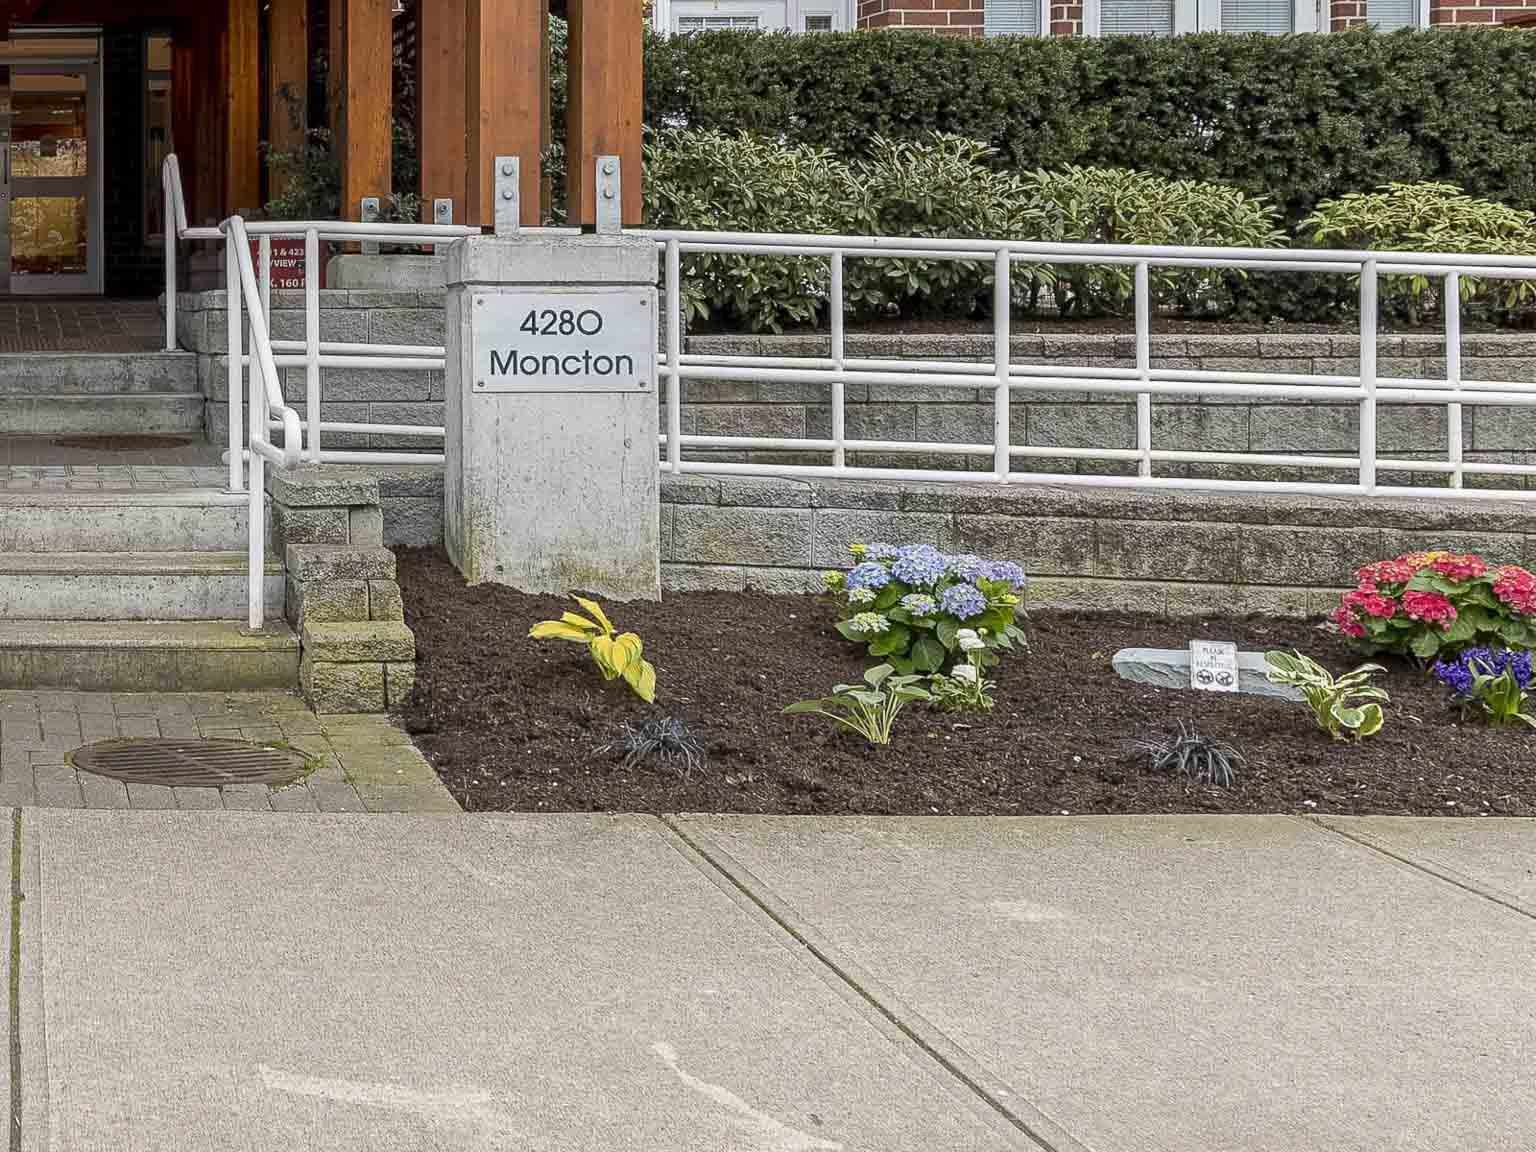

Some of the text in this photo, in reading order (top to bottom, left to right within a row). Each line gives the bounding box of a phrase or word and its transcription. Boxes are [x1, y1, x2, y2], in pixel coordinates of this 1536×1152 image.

[288, 248, 305, 256] 423
[280, 279, 299, 288] 160
[519, 309, 604, 336] 4280
[489, 349, 633, 376] Moncton
